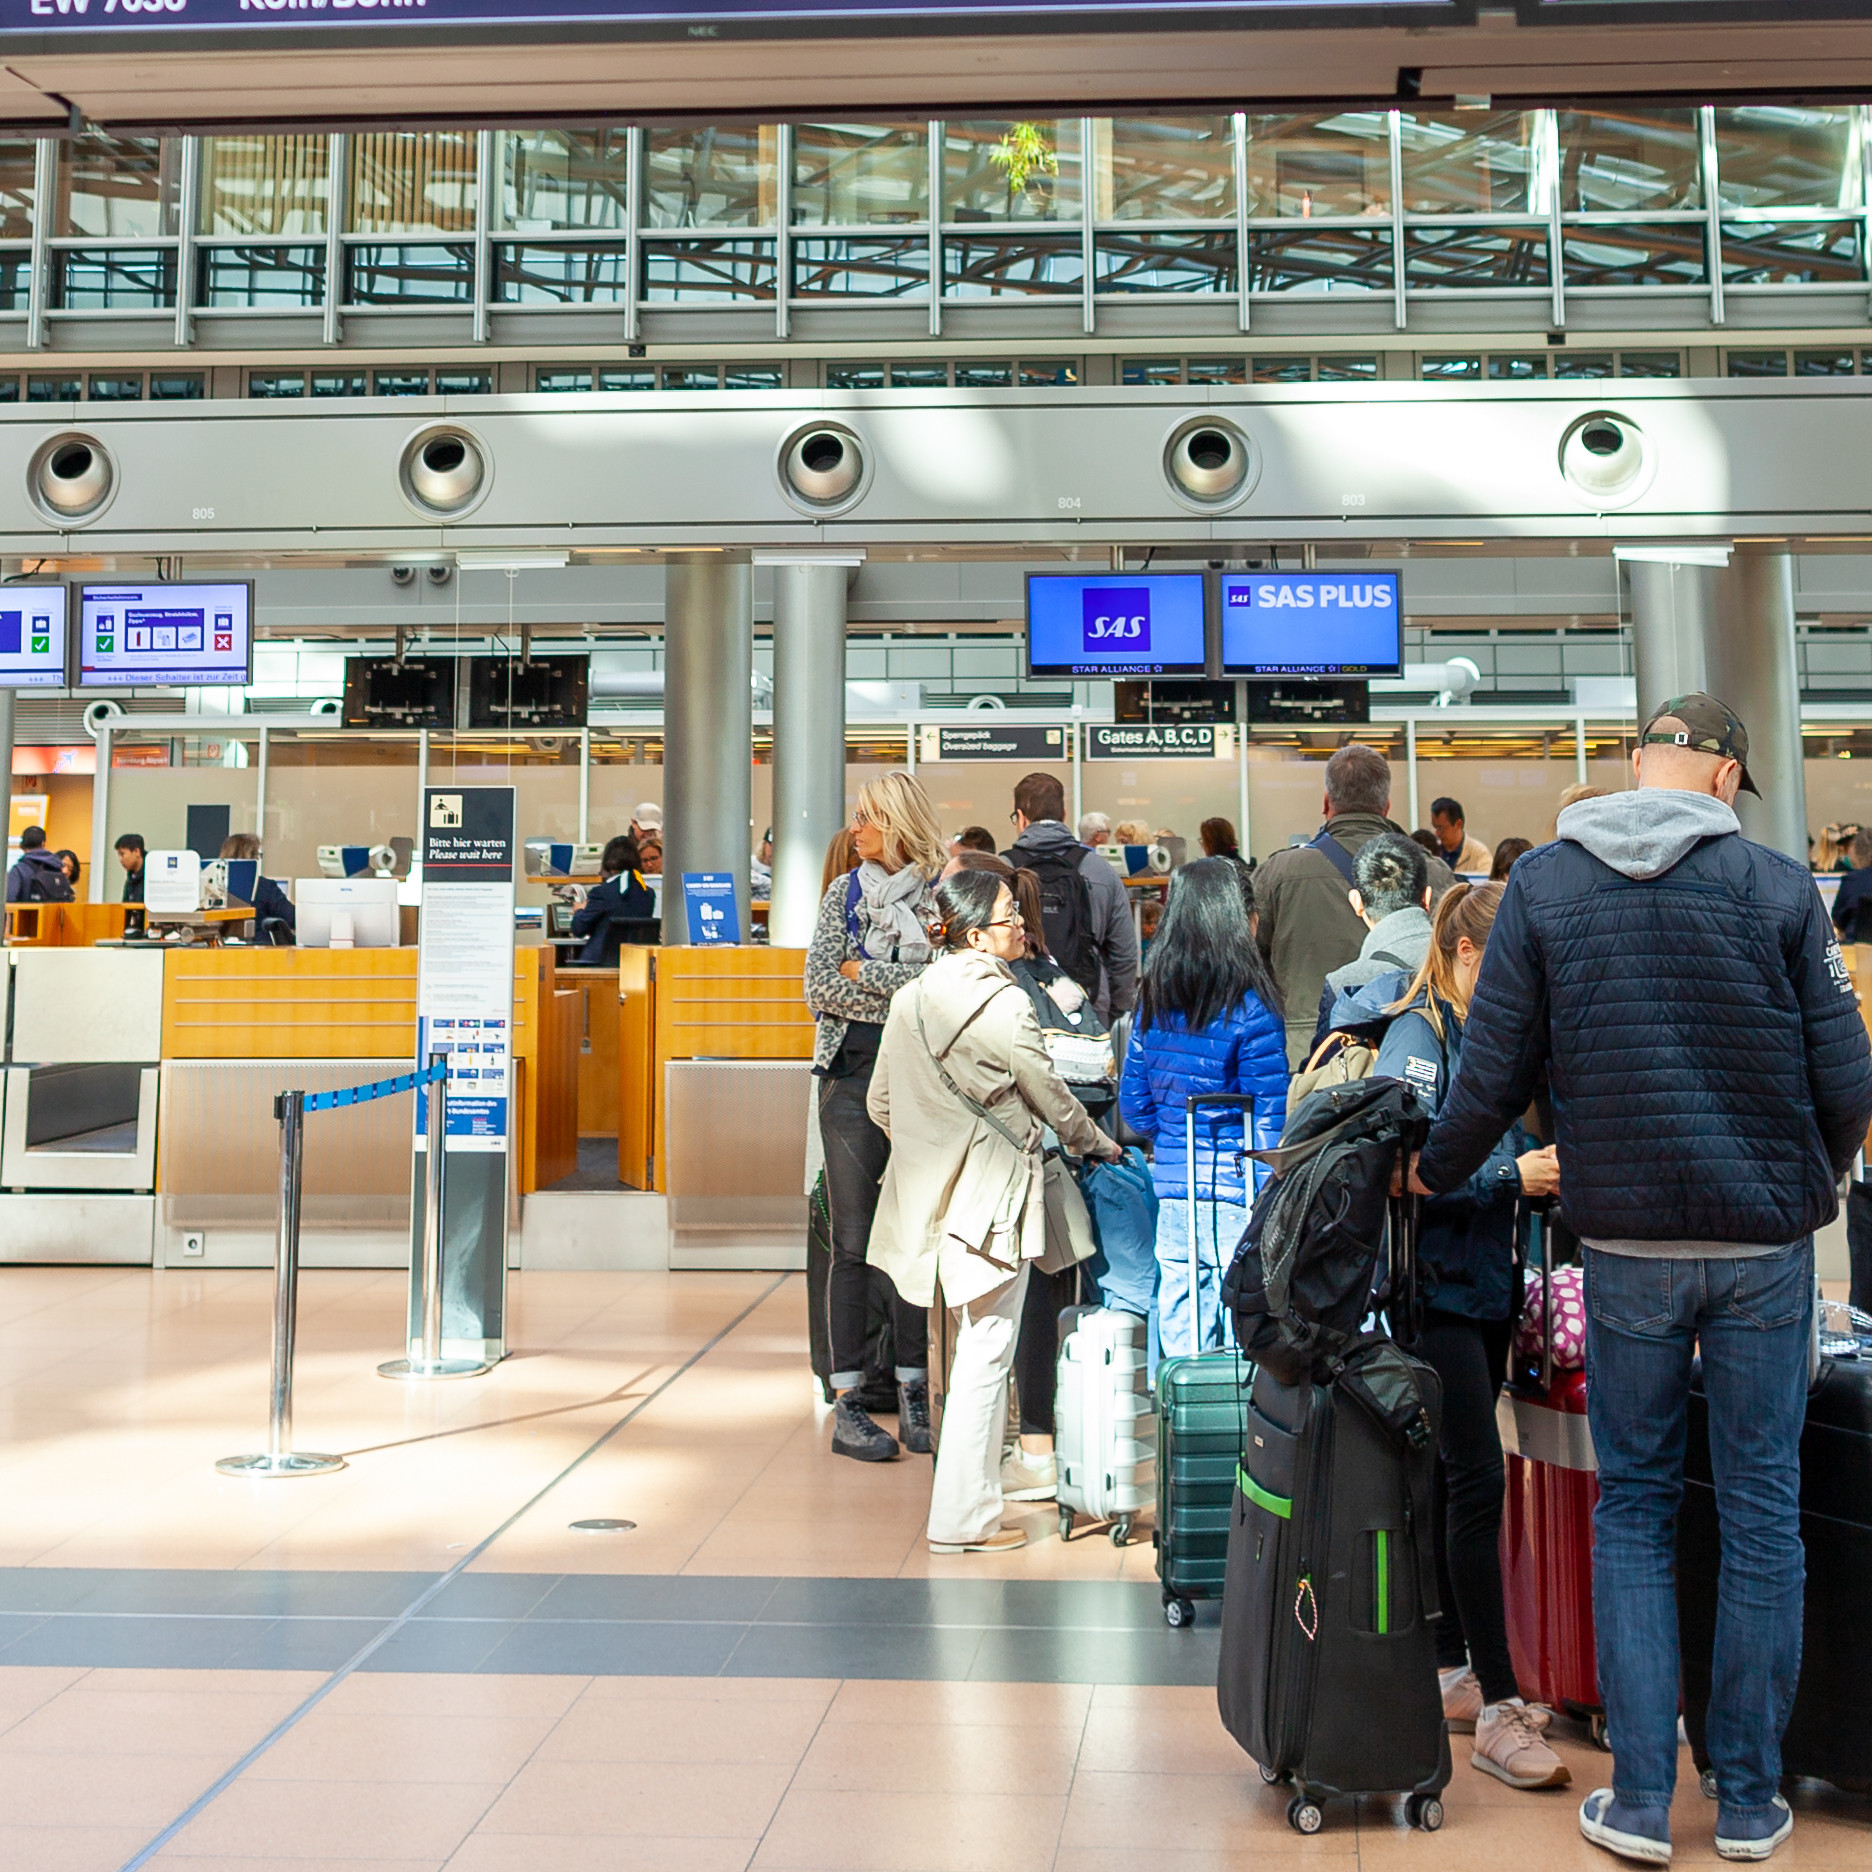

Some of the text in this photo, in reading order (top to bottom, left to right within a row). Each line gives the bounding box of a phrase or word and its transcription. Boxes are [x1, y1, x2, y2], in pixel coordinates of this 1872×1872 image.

[1057, 497, 1081, 509] 804
[1341, 494, 1366, 507] 803
[192, 508, 215, 520] 805
[1229, 594, 1251, 603] SAS
[1258, 584, 1392, 608] SAS PLUS
[1087, 616, 1146, 639] SAS
[1072, 665, 1151, 674] STAR ALLIANCE
[1254, 664, 1368, 673] STAR ALLIANCE GOLD
[125, 672, 239, 682] Dieser Schalter ist zur Zeit
[1097, 729, 1144, 745] Gates
[982, 742, 1018, 752] baggage
[429, 836, 506, 848] Bitte hier warten
[429, 849, 503, 860] Please wait here
